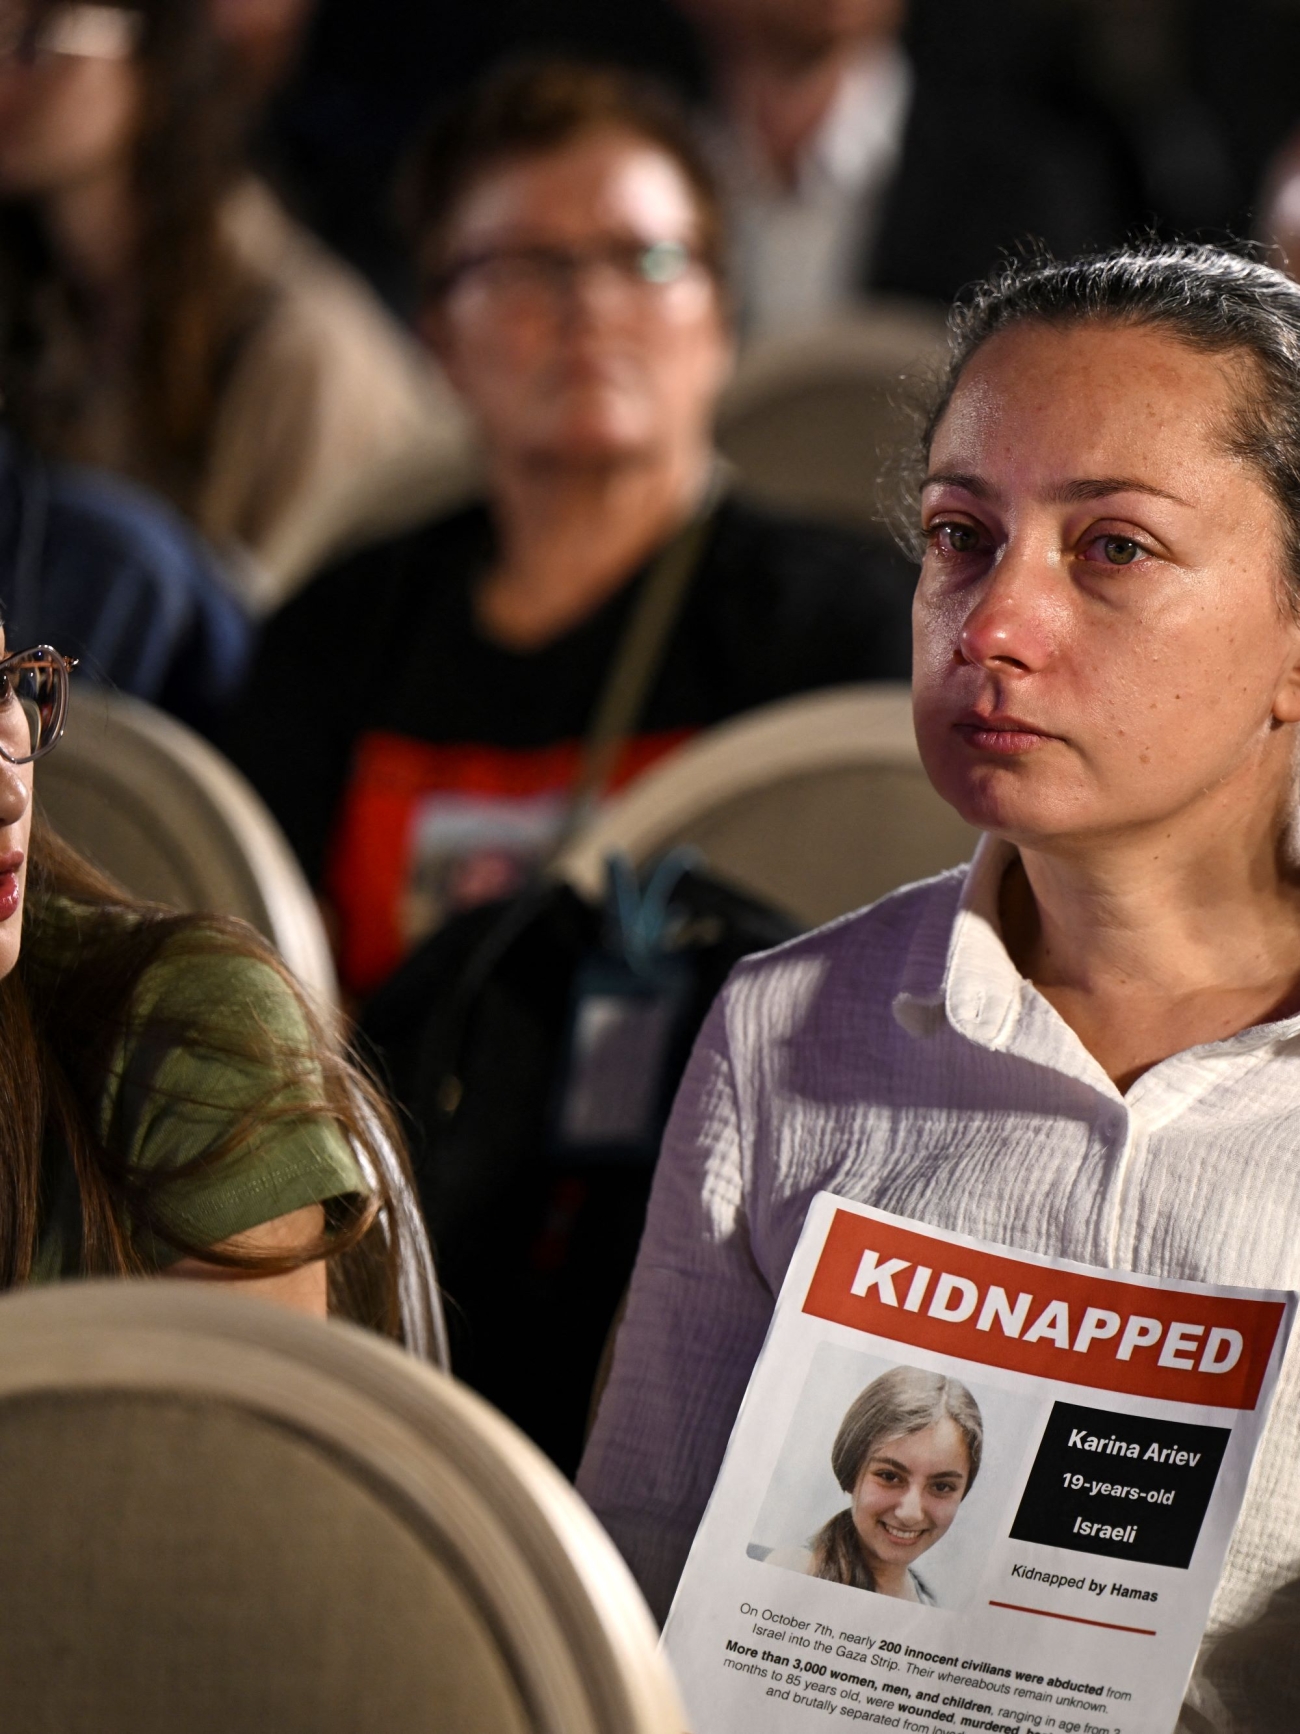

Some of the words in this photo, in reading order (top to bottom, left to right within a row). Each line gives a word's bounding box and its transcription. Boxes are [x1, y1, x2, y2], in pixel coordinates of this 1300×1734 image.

[850, 1249, 1244, 1374] KIDNAPPED
[1068, 1428, 1140, 1458] Karina
[1142, 1442, 1202, 1467] Ariev
[1062, 1472, 1175, 1505] 19-years-old
[1073, 1516, 1138, 1544] Israeli
[1011, 1564, 1086, 1589] Kidnapped
[1089, 1579, 1107, 1595] by
[1110, 1582, 1158, 1602] Hamas
[740, 1602, 758, 1616] On
[762, 1609, 811, 1630] October
[814, 1622, 834, 1639] 7th,
[839, 1631, 876, 1650] nearly
[878, 1640, 902, 1654] 200
[904, 1646, 959, 1667] innocent
[961, 1660, 1012, 1678] civilians
[1015, 1671, 1044, 1684] were
[1047, 1677, 1104, 1696] abducted
[1106, 1687, 1132, 1702] from
[752, 1624, 786, 1641] Israel
[788, 1632, 811, 1648] into
[813, 1640, 832, 1654] the
[836, 1646, 868, 1663] Gaza
[870, 1654, 900, 1672] Strip.
[906, 1662, 935, 1678] Their
[938, 1671, 1010, 1695] whereabouts
[1014, 1686, 1053, 1702] remain
[1056, 1696, 1108, 1714] unknown.
[723, 1658, 768, 1678] months
[771, 1670, 782, 1682] to
[786, 1674, 802, 1686] 85
[804, 1680, 837, 1696] years
[840, 1689, 862, 1704] old,
[866, 1696, 894, 1710] were
[898, 1703, 956, 1724] wounded,
[726, 1640, 758, 1658] More
[762, 1650, 790, 1666] than
[792, 1658, 828, 1676] 3,000
[830, 1670, 878, 1690] women,
[882, 1683, 912, 1699] men,
[916, 1691, 940, 1704] and
[942, 1696, 994, 1716] children,
[998, 1708, 1042, 1727] ranging
[1045, 1716, 1056, 1727] in
[1058, 1720, 1081, 1733] age
[1084, 1722, 1110, 1734] from
[766, 1687, 790, 1701] and
[792, 1692, 838, 1714] brutally
[840, 1706, 902, 1728] separated
[902, 1718, 930, 1734] from
